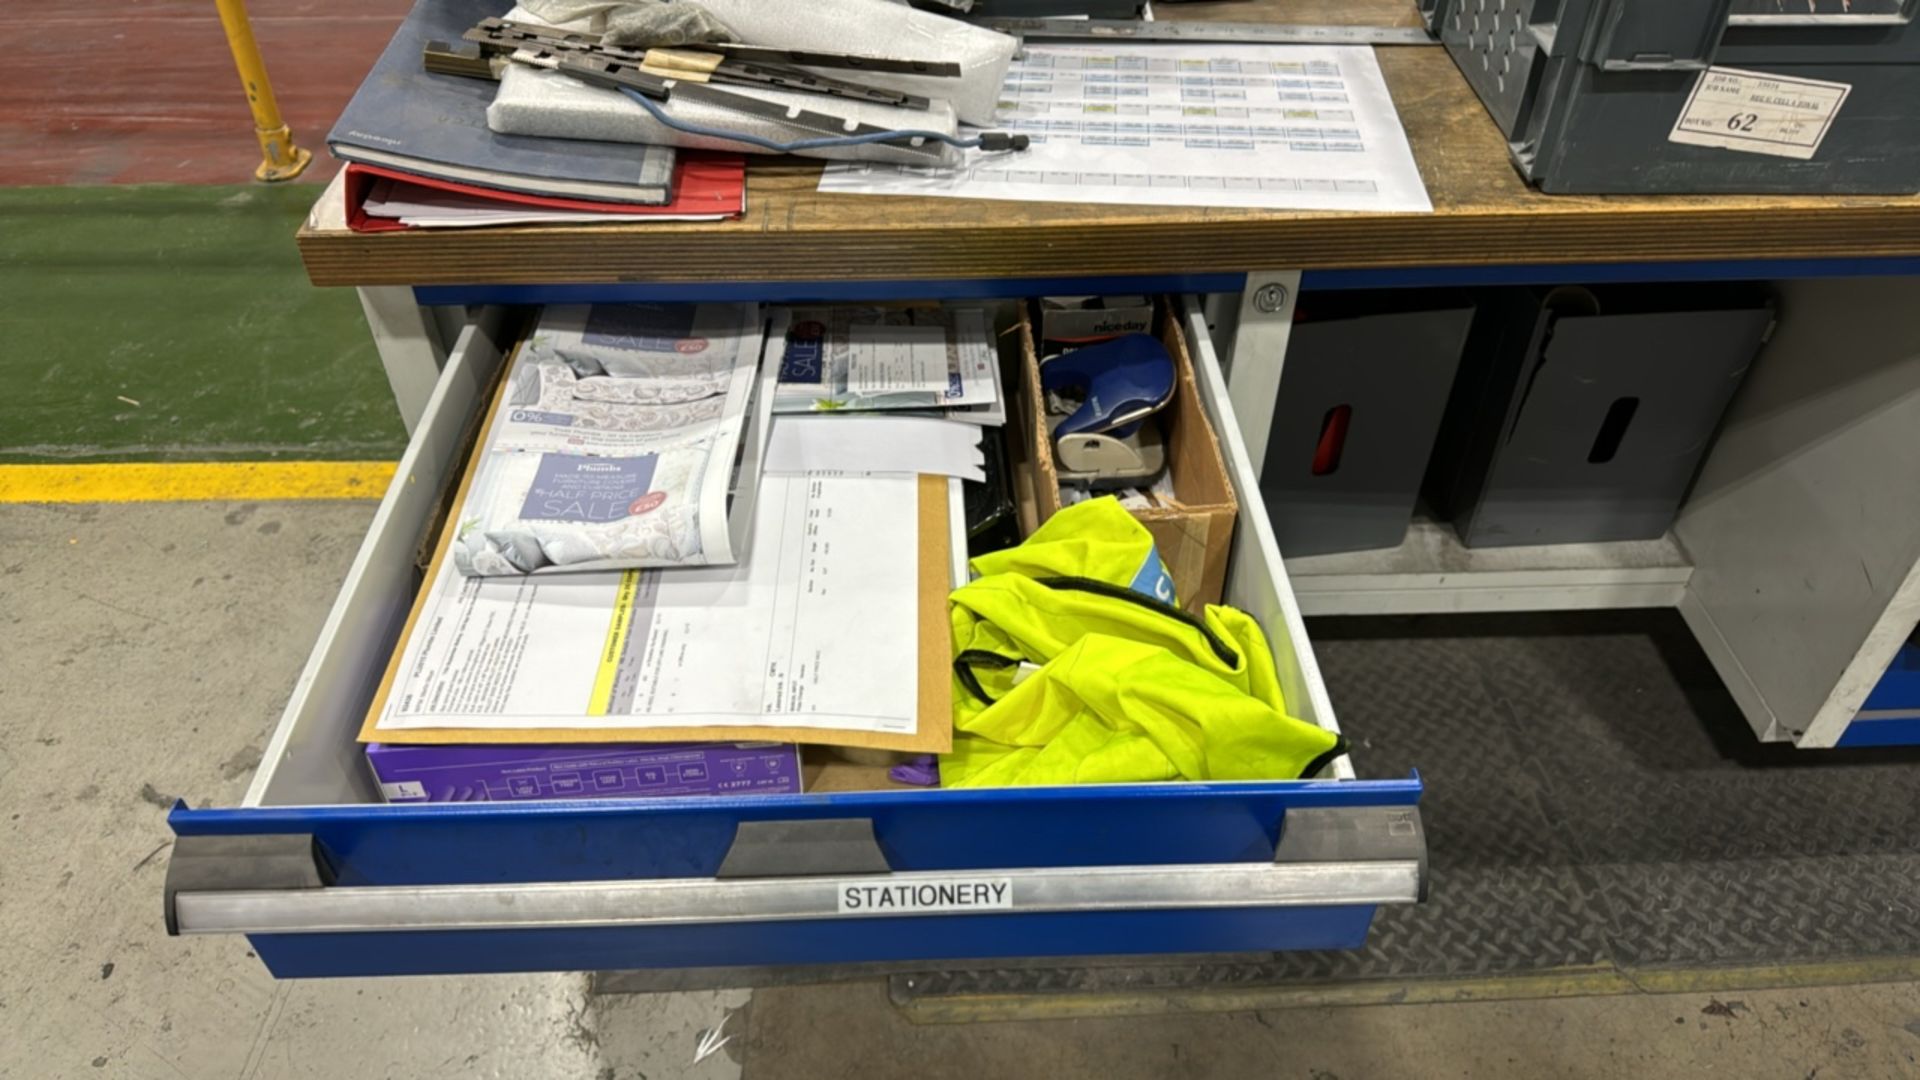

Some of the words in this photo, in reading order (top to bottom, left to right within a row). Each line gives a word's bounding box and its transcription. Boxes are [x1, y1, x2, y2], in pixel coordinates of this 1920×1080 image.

[1727, 112, 1758, 132] 62
[791, 341, 818, 377] SALE
[513, 411, 542, 422] 0%
[590, 488, 640, 500] PRICE
[541, 500, 629, 519] SALE
[606, 631, 620, 663] CUSTOMER
[845, 883, 1007, 909] STATIONERY
